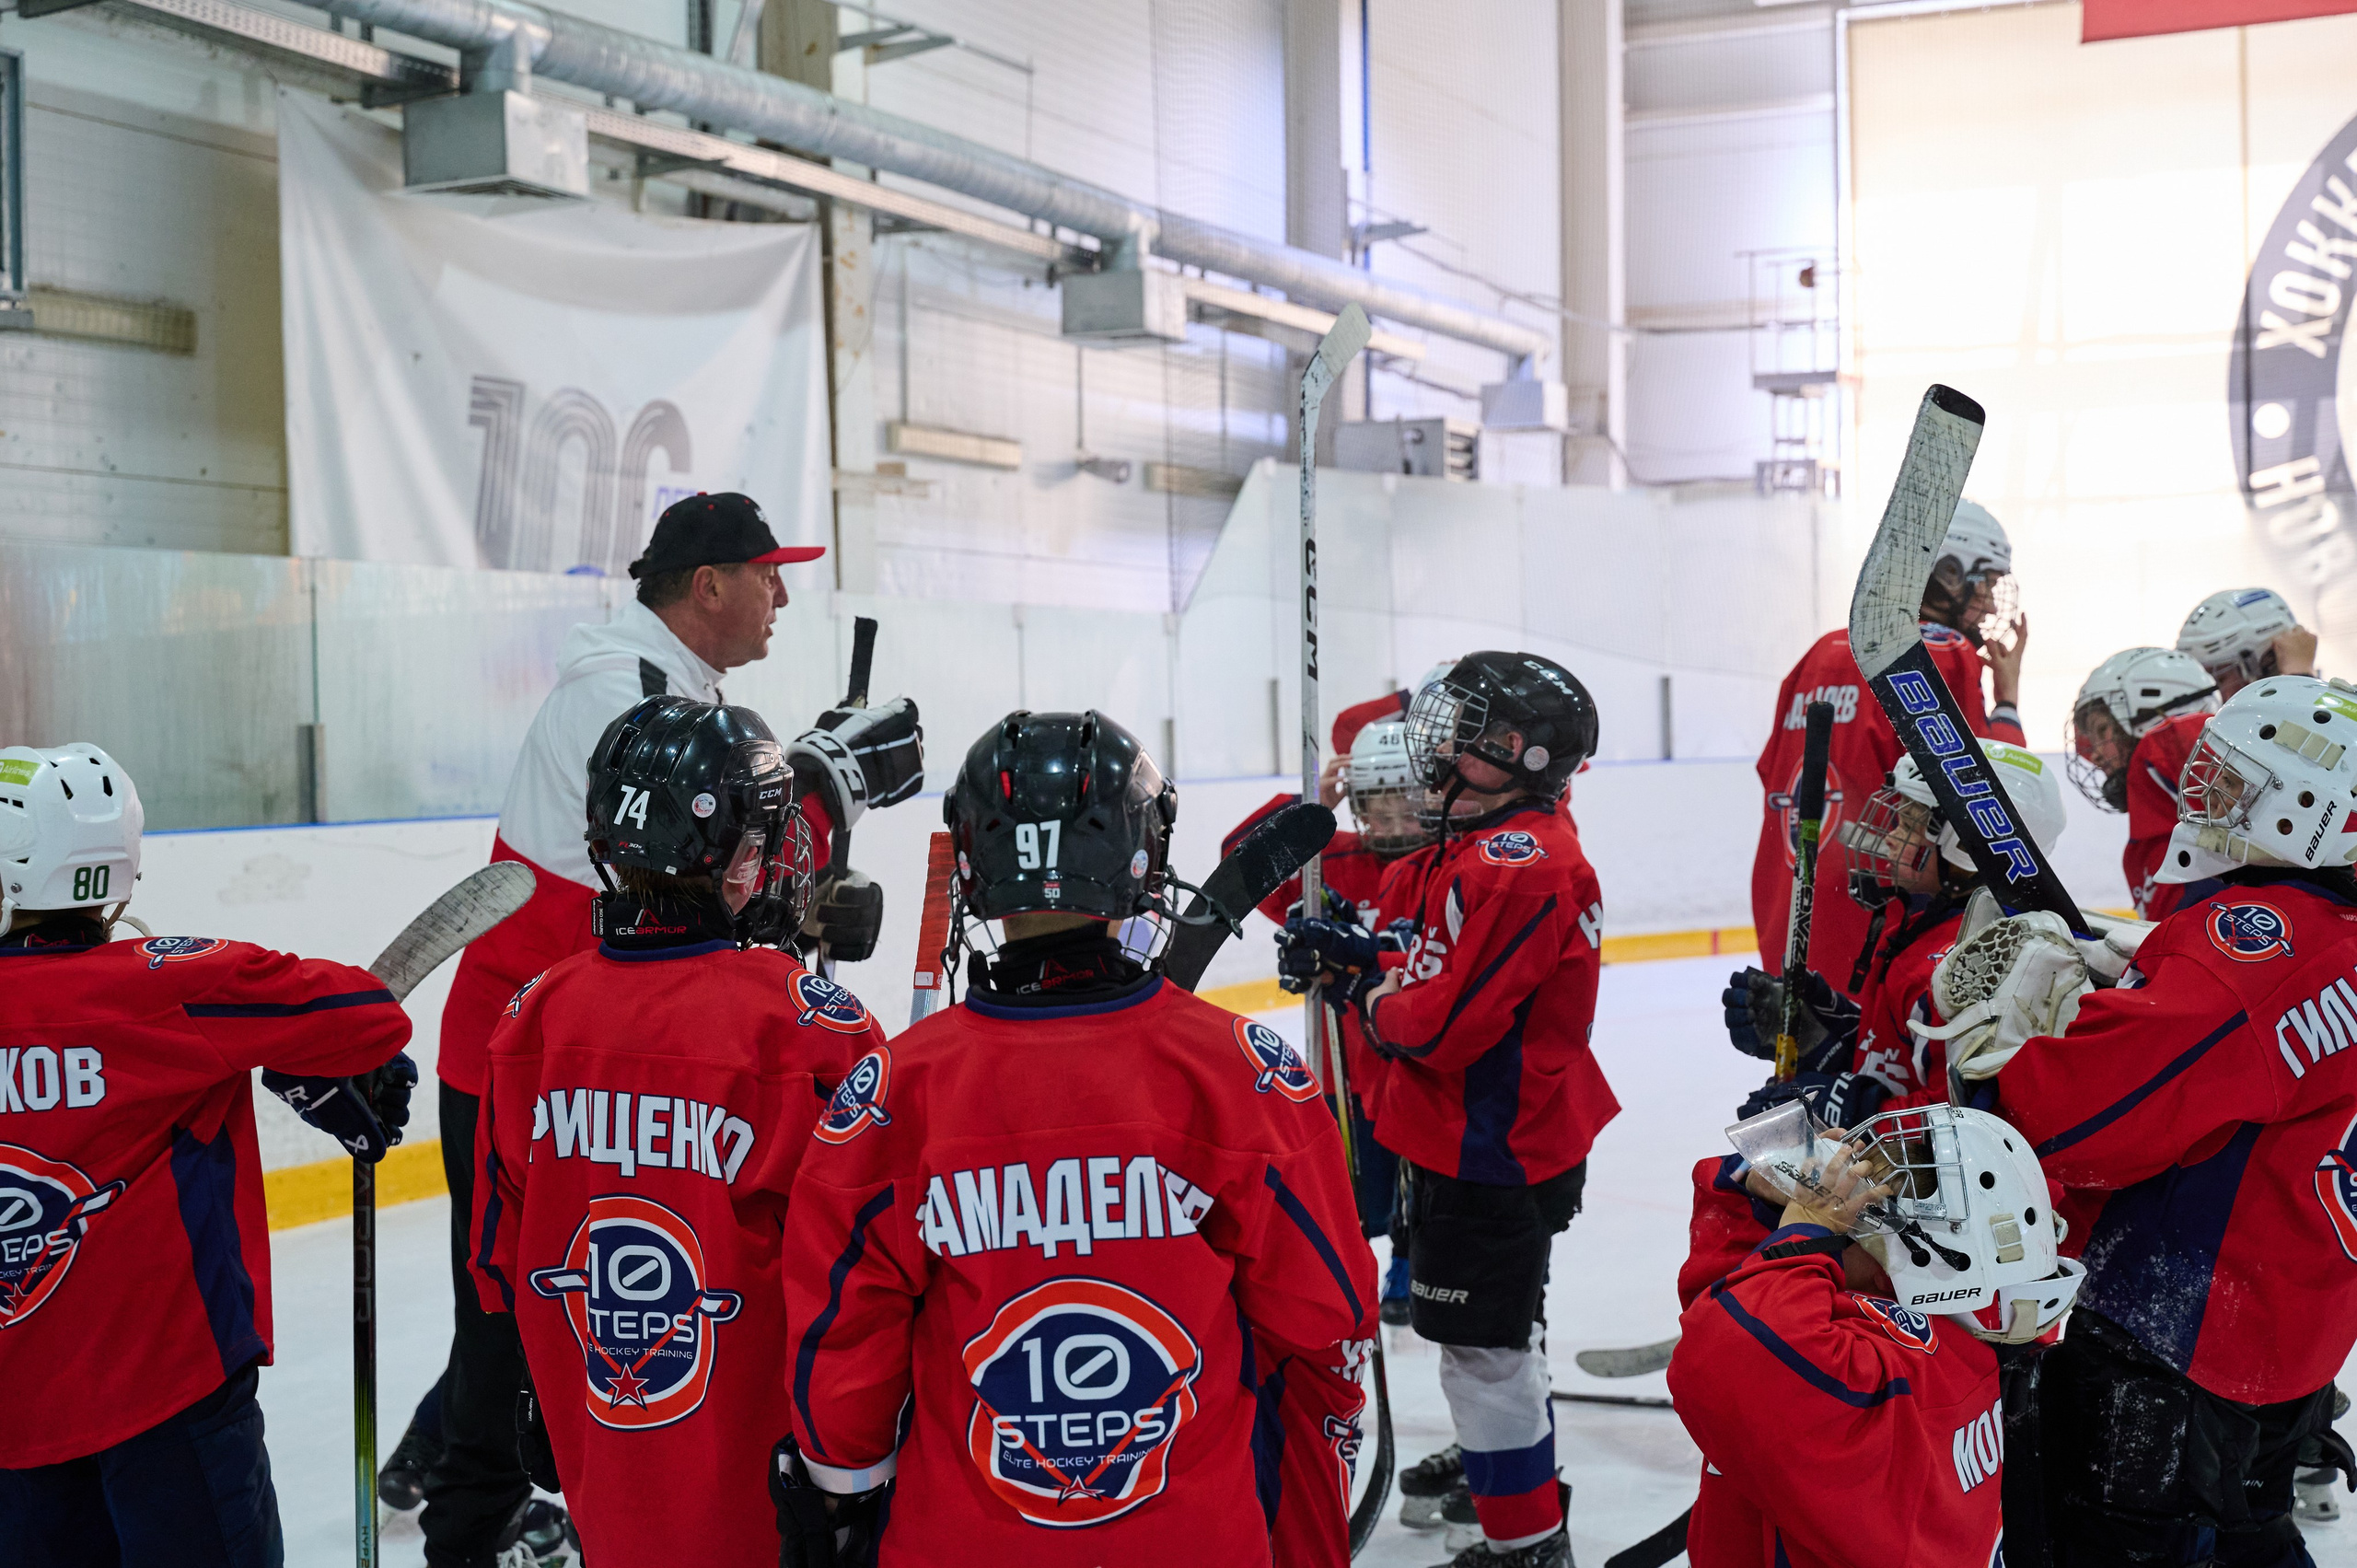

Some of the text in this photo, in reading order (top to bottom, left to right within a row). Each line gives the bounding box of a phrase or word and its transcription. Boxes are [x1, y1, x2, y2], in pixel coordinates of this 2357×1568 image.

[2255, 152, 2357, 358] ХОКК
[1306, 538, 1318, 682] CCM
[1524, 659, 1573, 695] CCM
[759, 788, 783, 800] CCM
[1886, 669, 2039, 886] BAUER
[613, 784, 650, 830] 74
[1016, 819, 1061, 869] 97
[1490, 842, 1531, 854] STEPS
[1502, 830, 1529, 842] 10
[2305, 800, 2337, 862] BAUER
[73, 865, 110, 900] 80
[1044, 888, 1061, 899] 50
[2223, 914, 2272, 947] STEPS
[2242, 907, 2277, 931] 10
[150, 937, 180, 952] 10
[803, 977, 836, 998] 10
[1253, 1026, 1280, 1056] 10
[850, 1058, 876, 1095] 10
[589, 1241, 672, 1302] 10
[1910, 1286, 1982, 1306] BAUER
[587, 1307, 695, 1343] TEPS
[594, 1347, 693, 1360] HOCKEY TRAINING
[1021, 1334, 1131, 1403] 10
[992, 1407, 1167, 1449] STEPS
[1003, 1449, 1032, 1469] ELITE
[1036, 1456, 1095, 1469] HOCKEY
